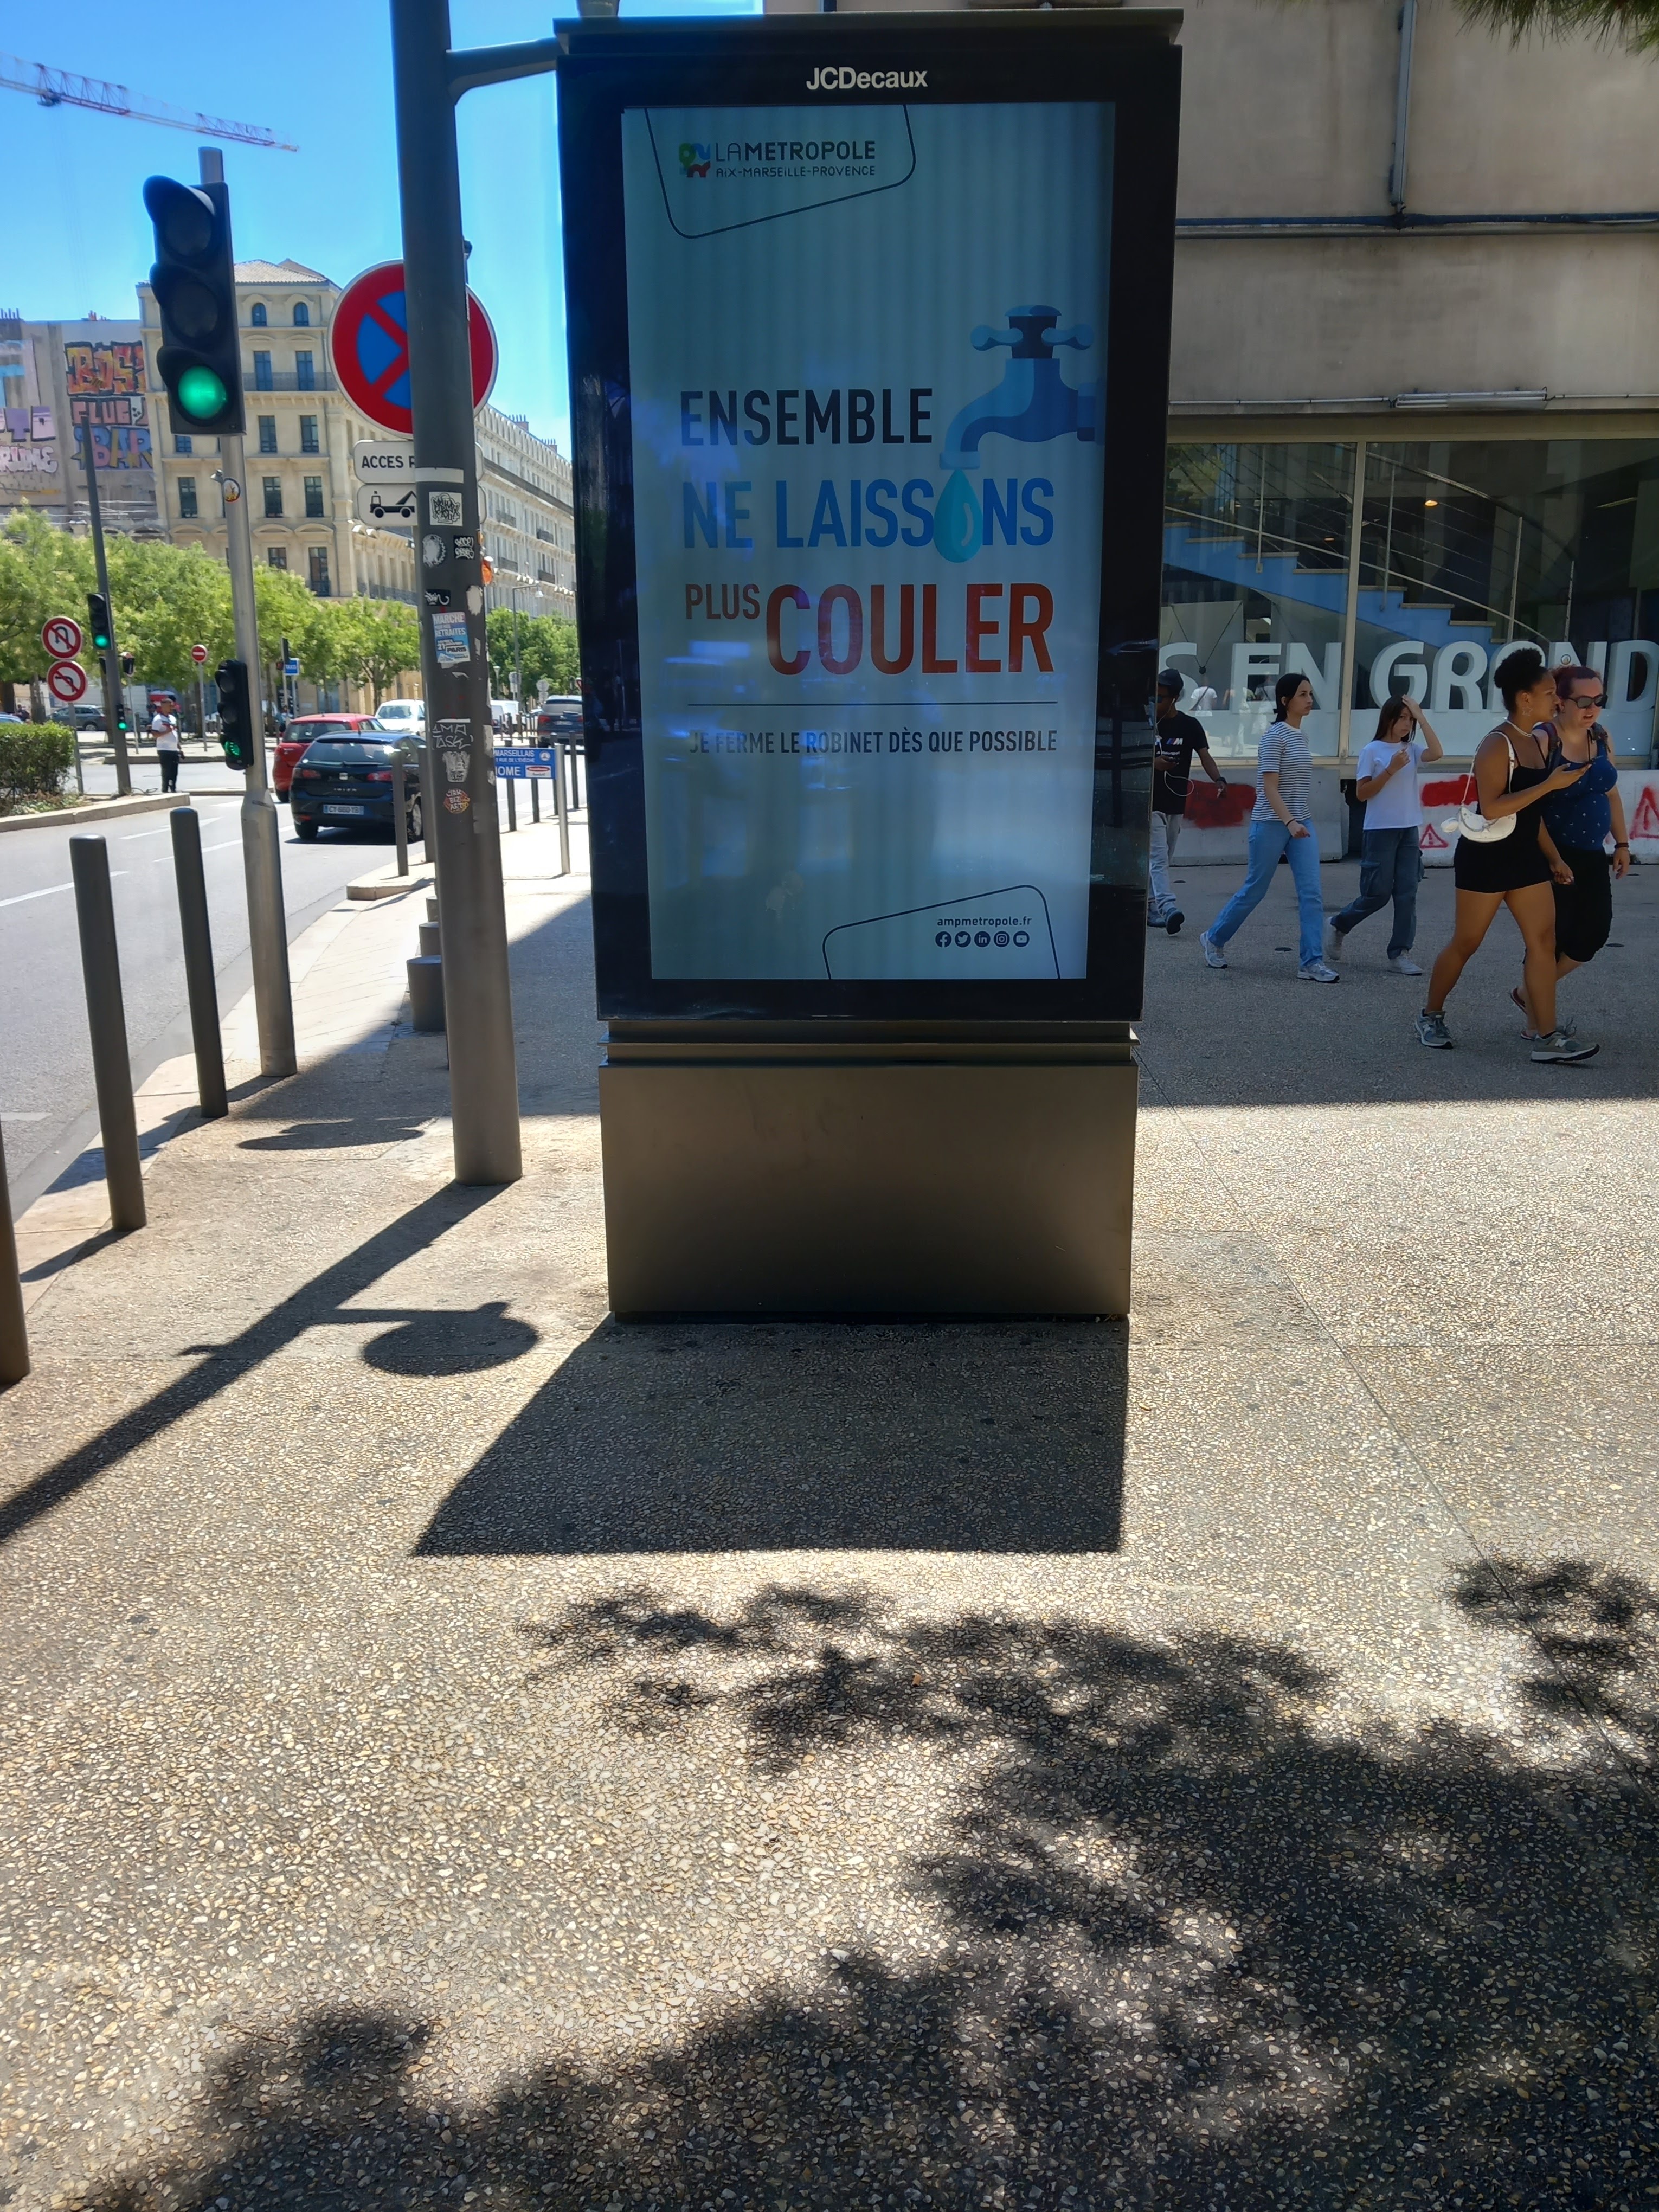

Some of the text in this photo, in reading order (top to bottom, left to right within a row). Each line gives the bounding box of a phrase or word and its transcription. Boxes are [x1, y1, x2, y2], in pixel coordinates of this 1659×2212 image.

[806, 67, 928, 90] JCDecaux
[680, 388, 933, 446] ENSEMBLE
[362, 455, 404, 468] ACCES
[683, 481, 753, 548] NE
[685, 583, 1054, 676] PLUS COULER
[1230, 642, 1342, 713] EN
[690, 726, 1057, 753] JE FERME LE ROBINET DÈS QUE POSSIBLE
[937, 916, 1032, 928] ampmetropole.fr
